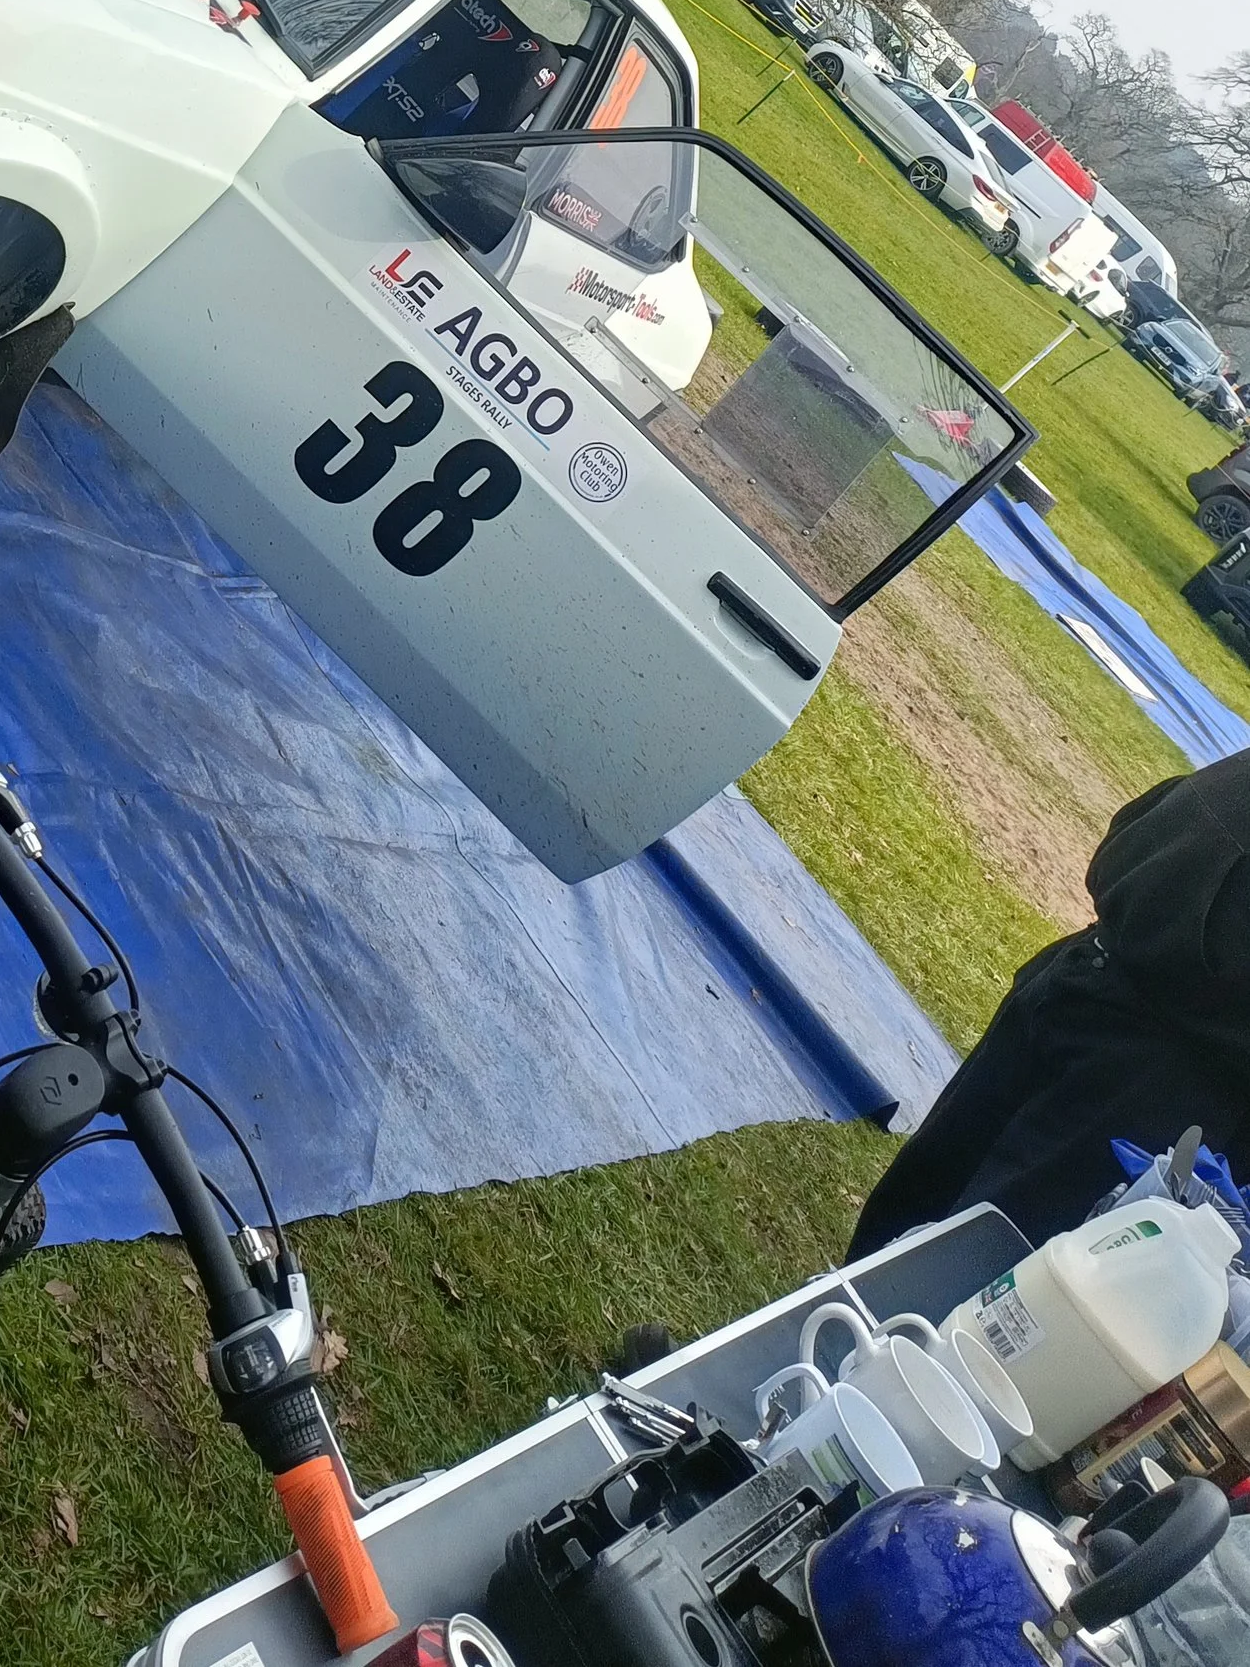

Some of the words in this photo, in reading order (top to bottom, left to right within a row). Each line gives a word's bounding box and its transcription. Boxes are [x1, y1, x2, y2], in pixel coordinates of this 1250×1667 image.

[550, 190, 593, 224] MORRIS
[366, 280, 413, 324] MAINTENANCE
[368, 264, 427, 323] LAND&ESTATE
[433, 305, 575, 435] AGBO
[444, 365, 482, 403] STAGES
[479, 399, 513, 430] RALLY
[293, 360, 522, 578] 38
[578, 451, 620, 496] Motoring
[578, 468, 603, 493] Club
[593, 449, 620, 476] Owen
